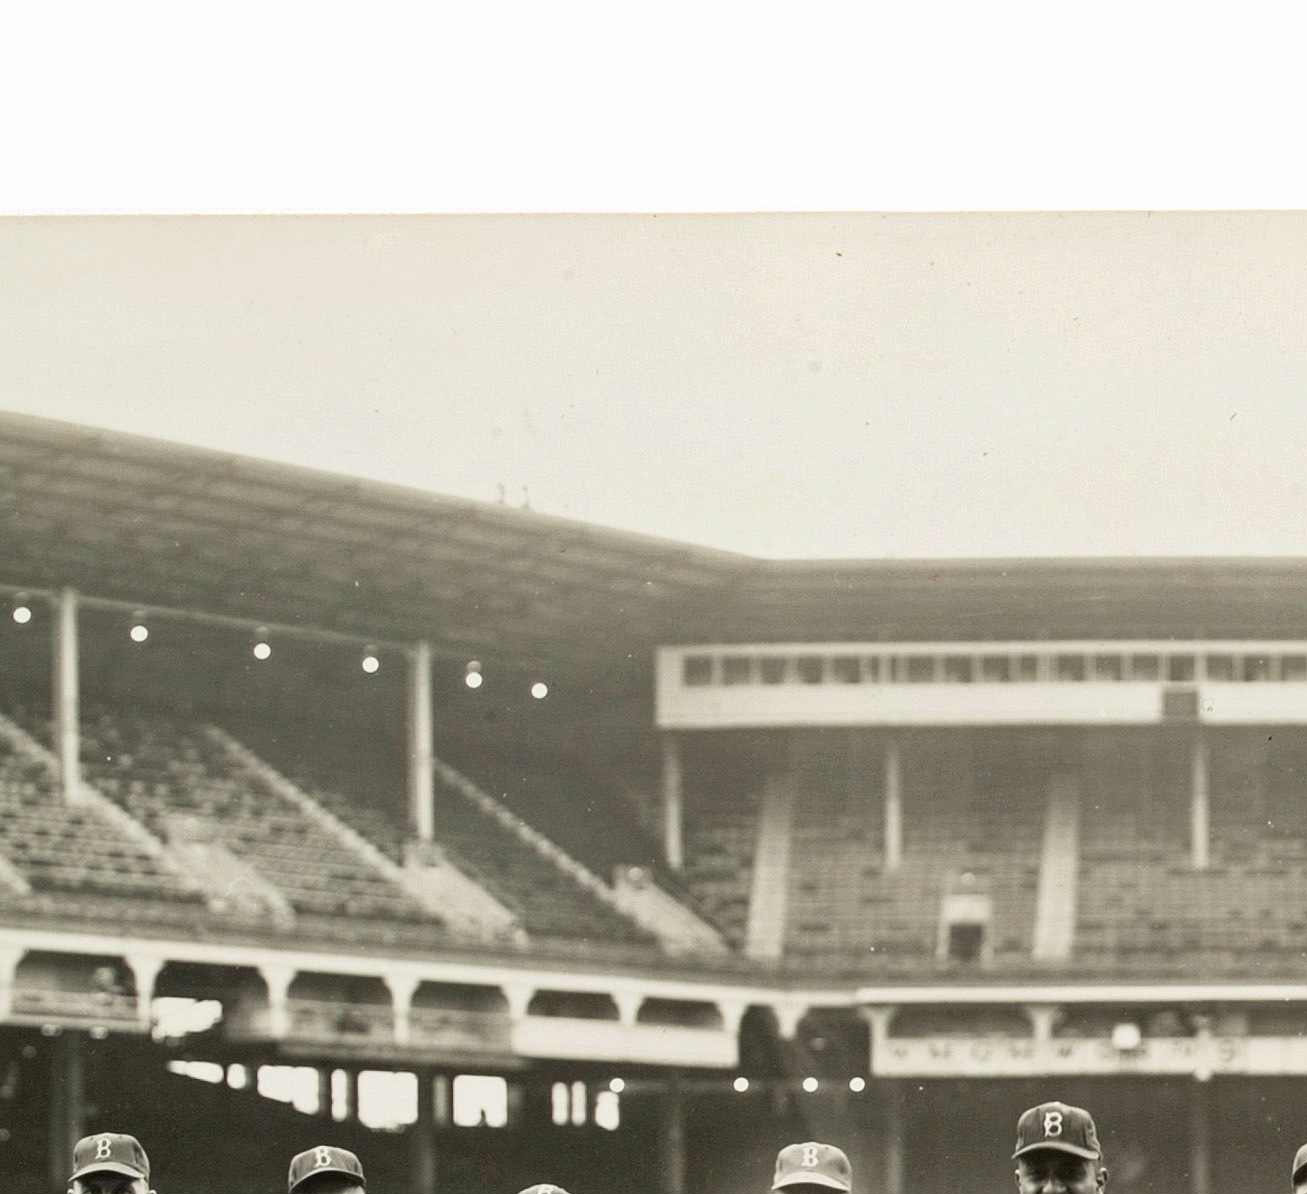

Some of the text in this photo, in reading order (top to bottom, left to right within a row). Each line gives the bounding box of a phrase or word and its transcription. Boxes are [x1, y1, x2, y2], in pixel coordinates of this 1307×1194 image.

[1043, 1111, 1062, 1137] B
[94, 1138, 111, 1160] B
[315, 1147, 331, 1167] B
[800, 1145, 819, 1167] B
